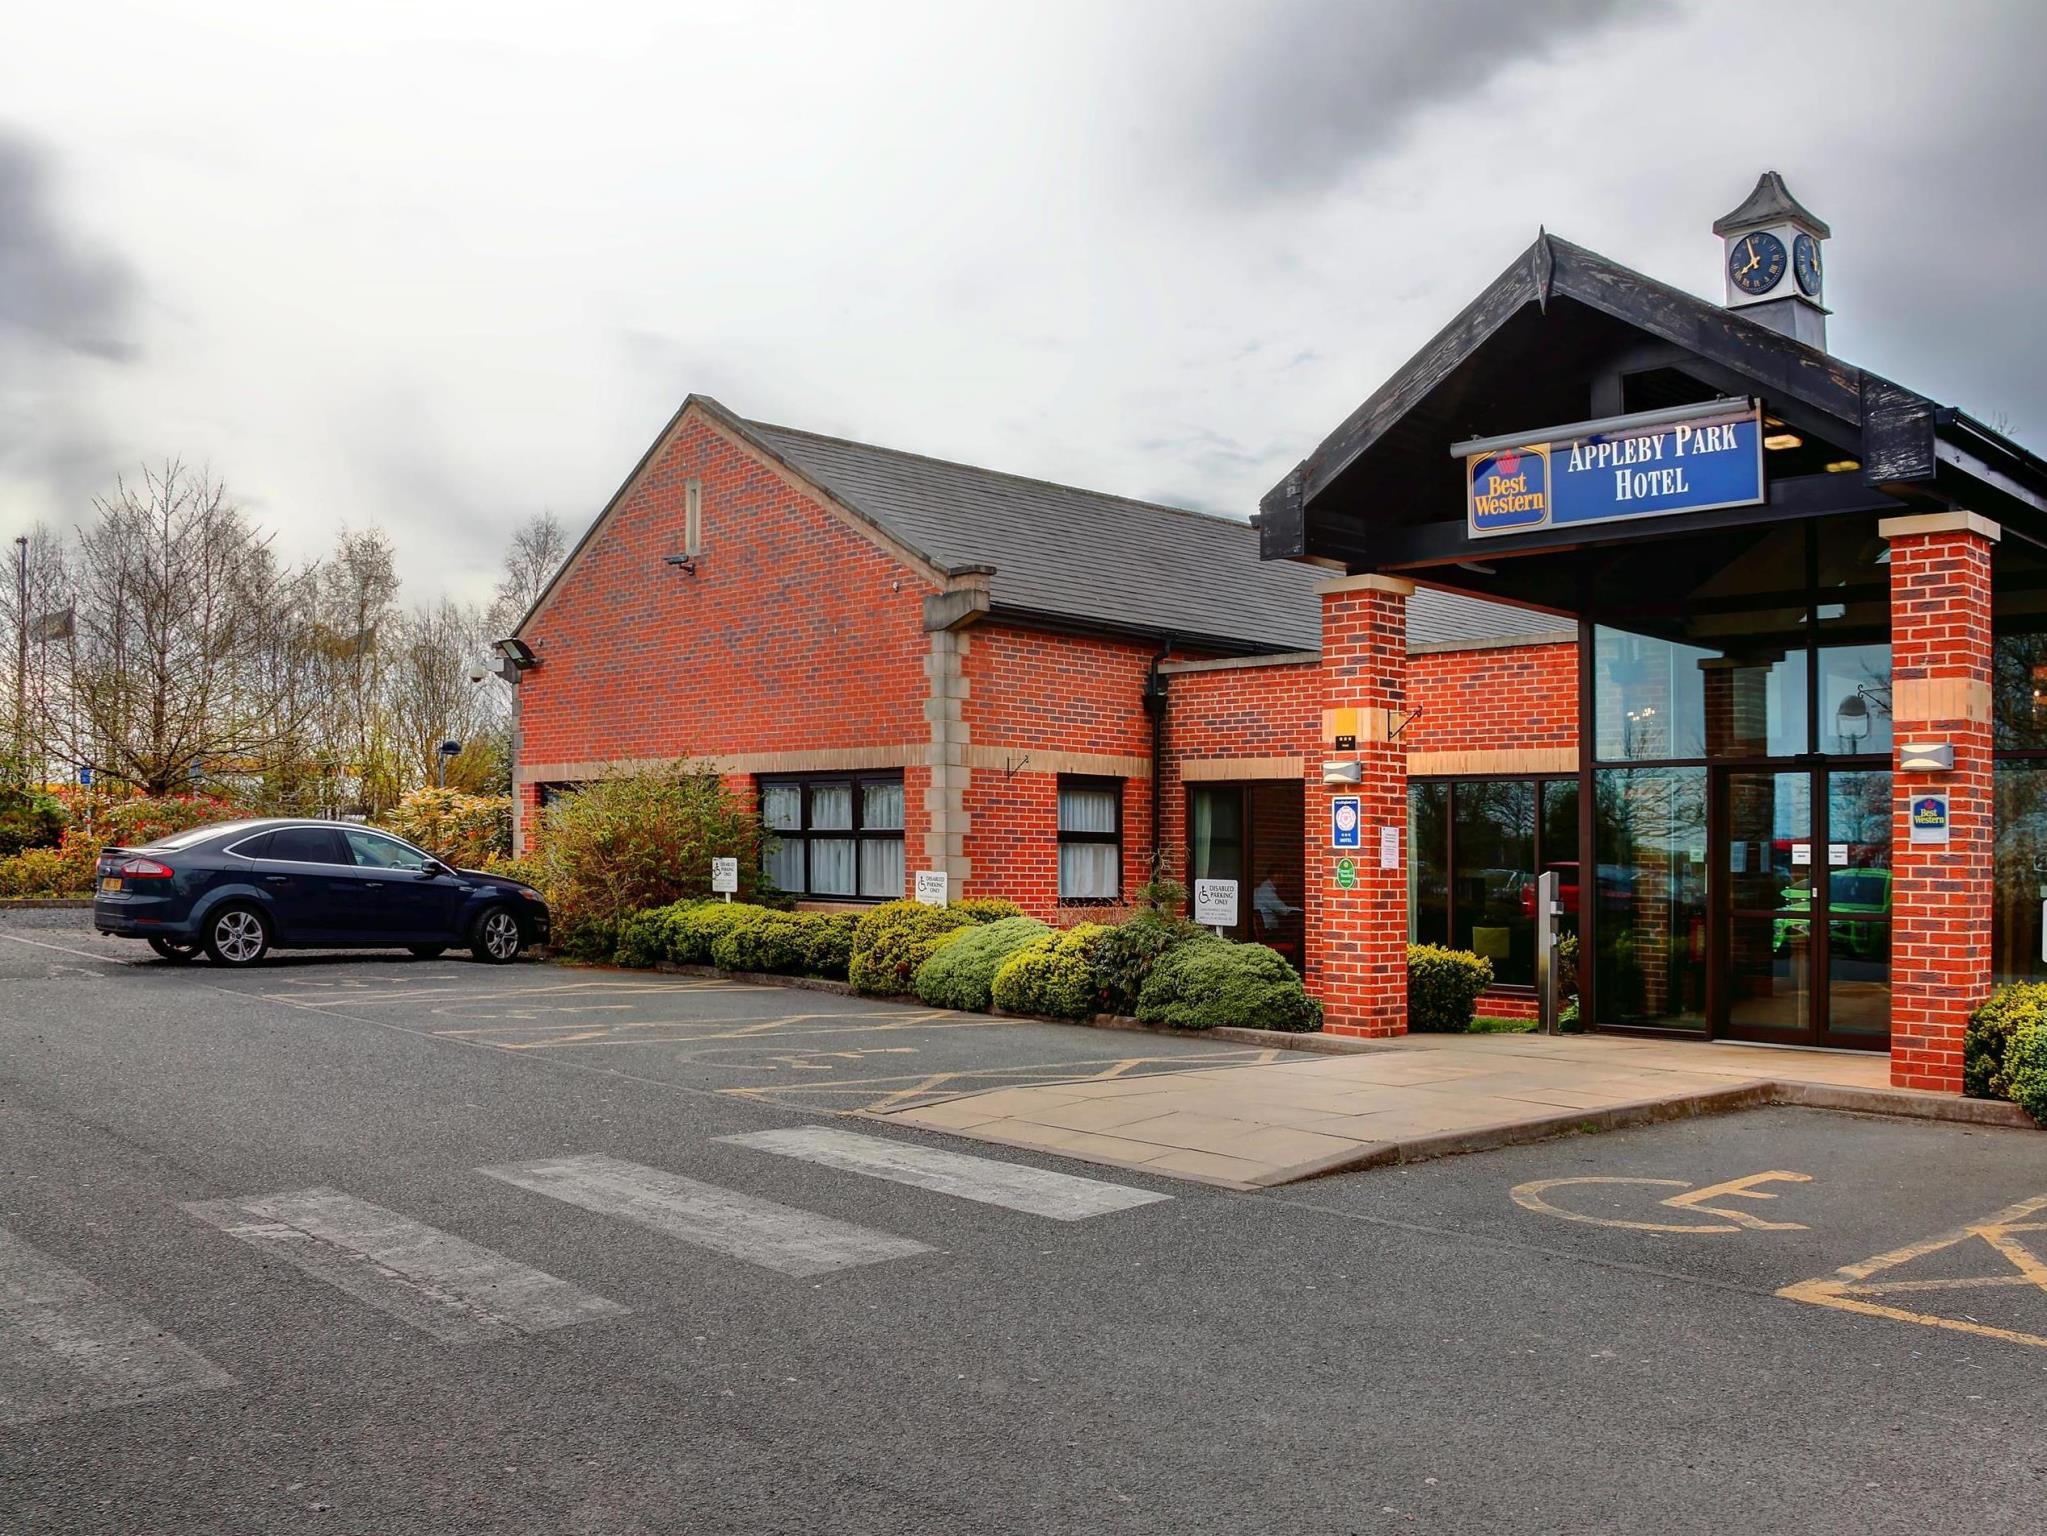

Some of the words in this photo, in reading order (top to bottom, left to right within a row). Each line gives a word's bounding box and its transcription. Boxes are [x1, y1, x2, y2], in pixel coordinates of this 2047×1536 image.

[1567, 434, 1666, 473] APPLEBY
[1674, 423, 1739, 458] PARK
[1488, 471, 1527, 497] Best
[1614, 467, 1689, 501] HOTEL
[1474, 489, 1545, 517] Western
[1913, 815, 1945, 824] Western
[1920, 808, 1938, 817] Best
